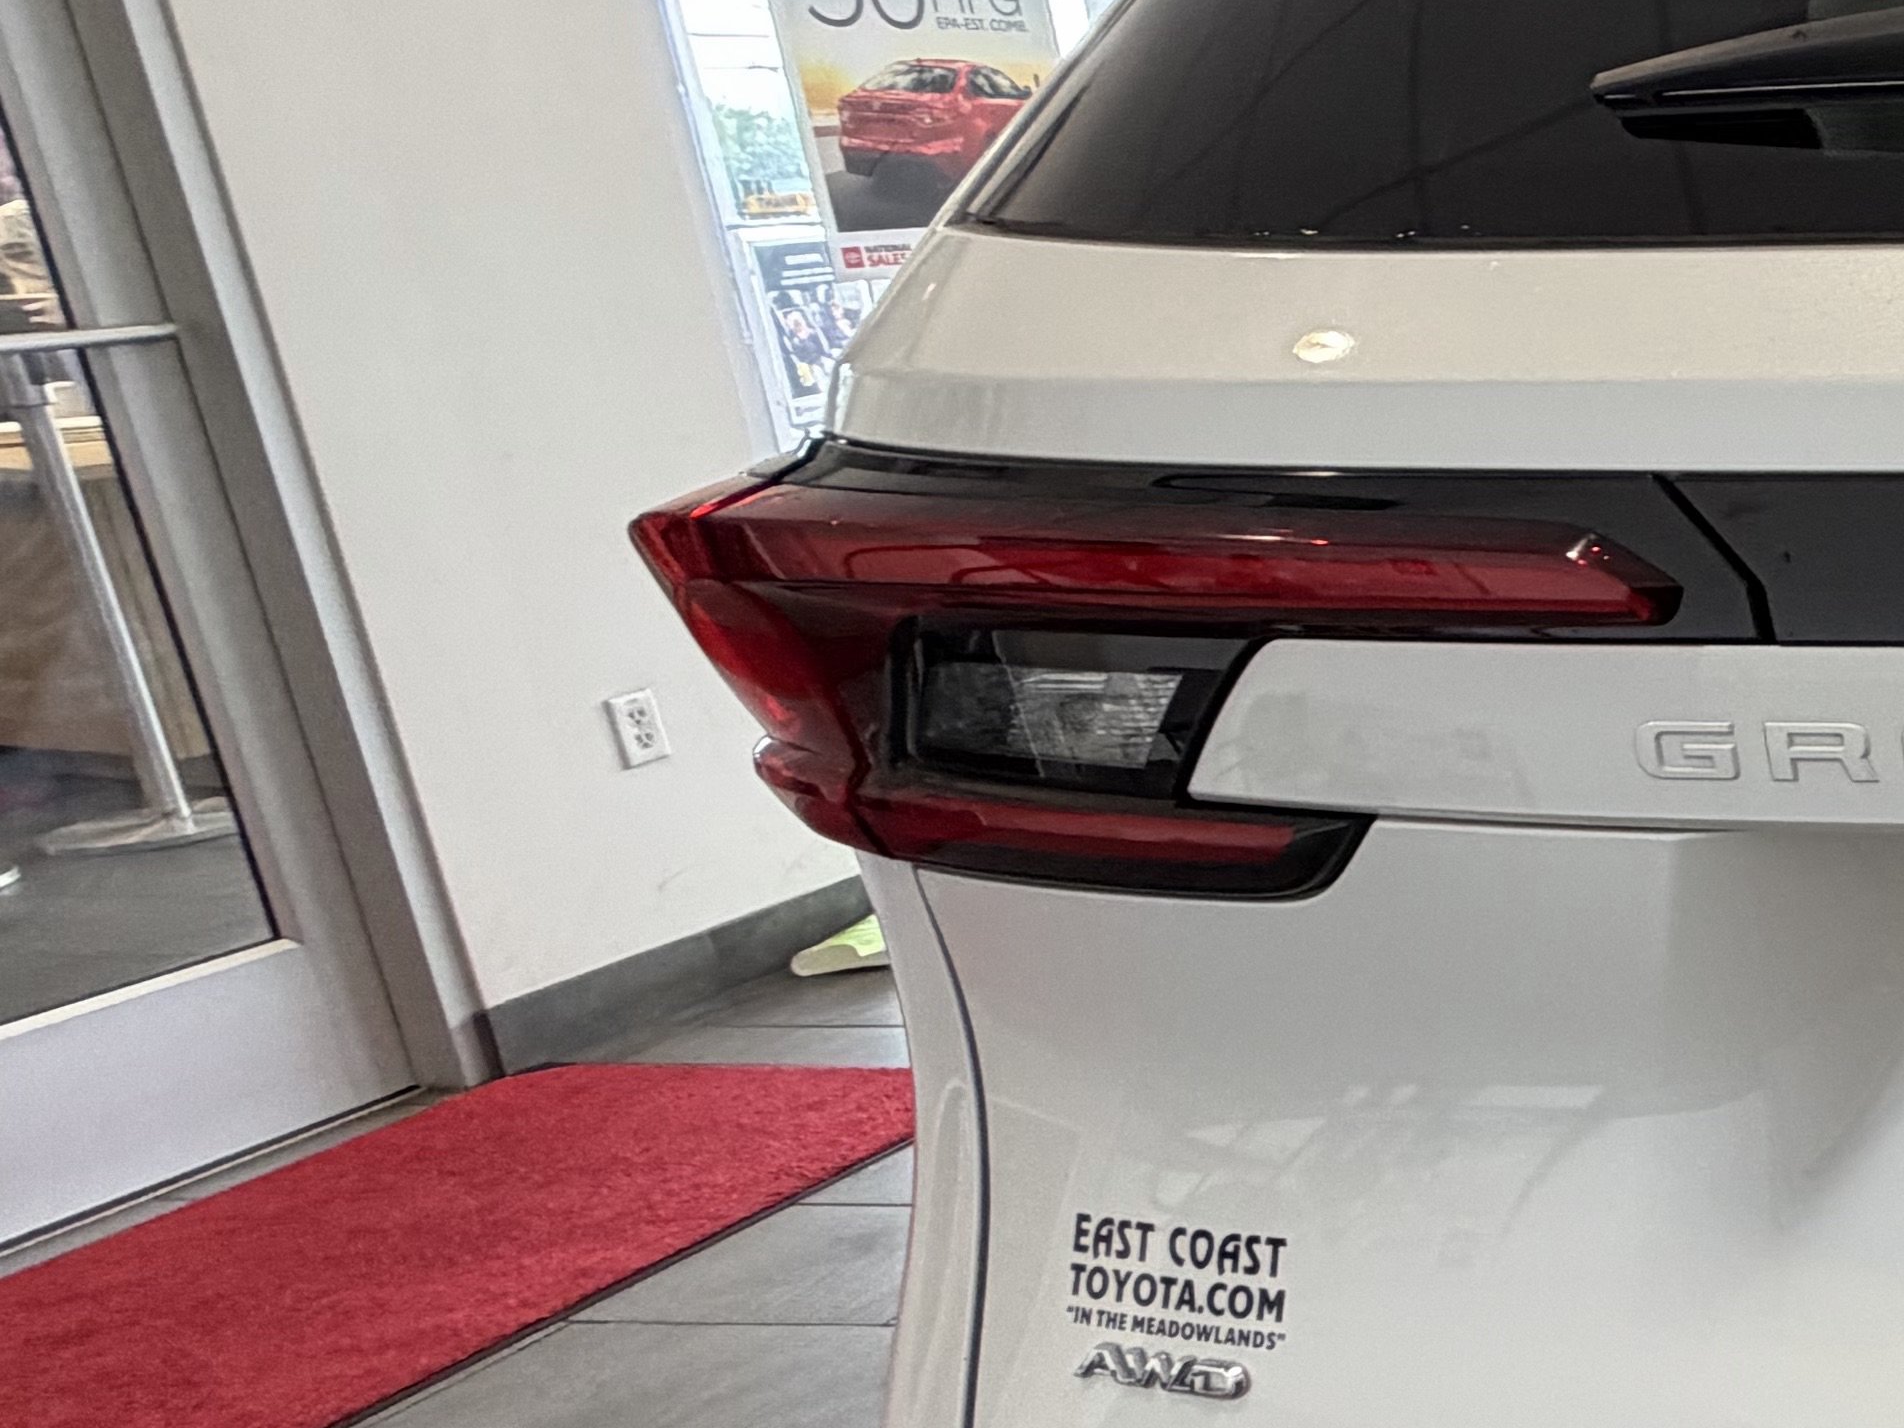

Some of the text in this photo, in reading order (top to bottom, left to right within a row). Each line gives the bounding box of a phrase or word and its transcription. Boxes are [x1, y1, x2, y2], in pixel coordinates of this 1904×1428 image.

[1073, 1213, 1288, 1278] EAST COAST
[1070, 1263, 1286, 1323] TOYOTA.COM
[1096, 1309, 1128, 1332] THE
[1072, 1341, 1253, 1401] AWD
